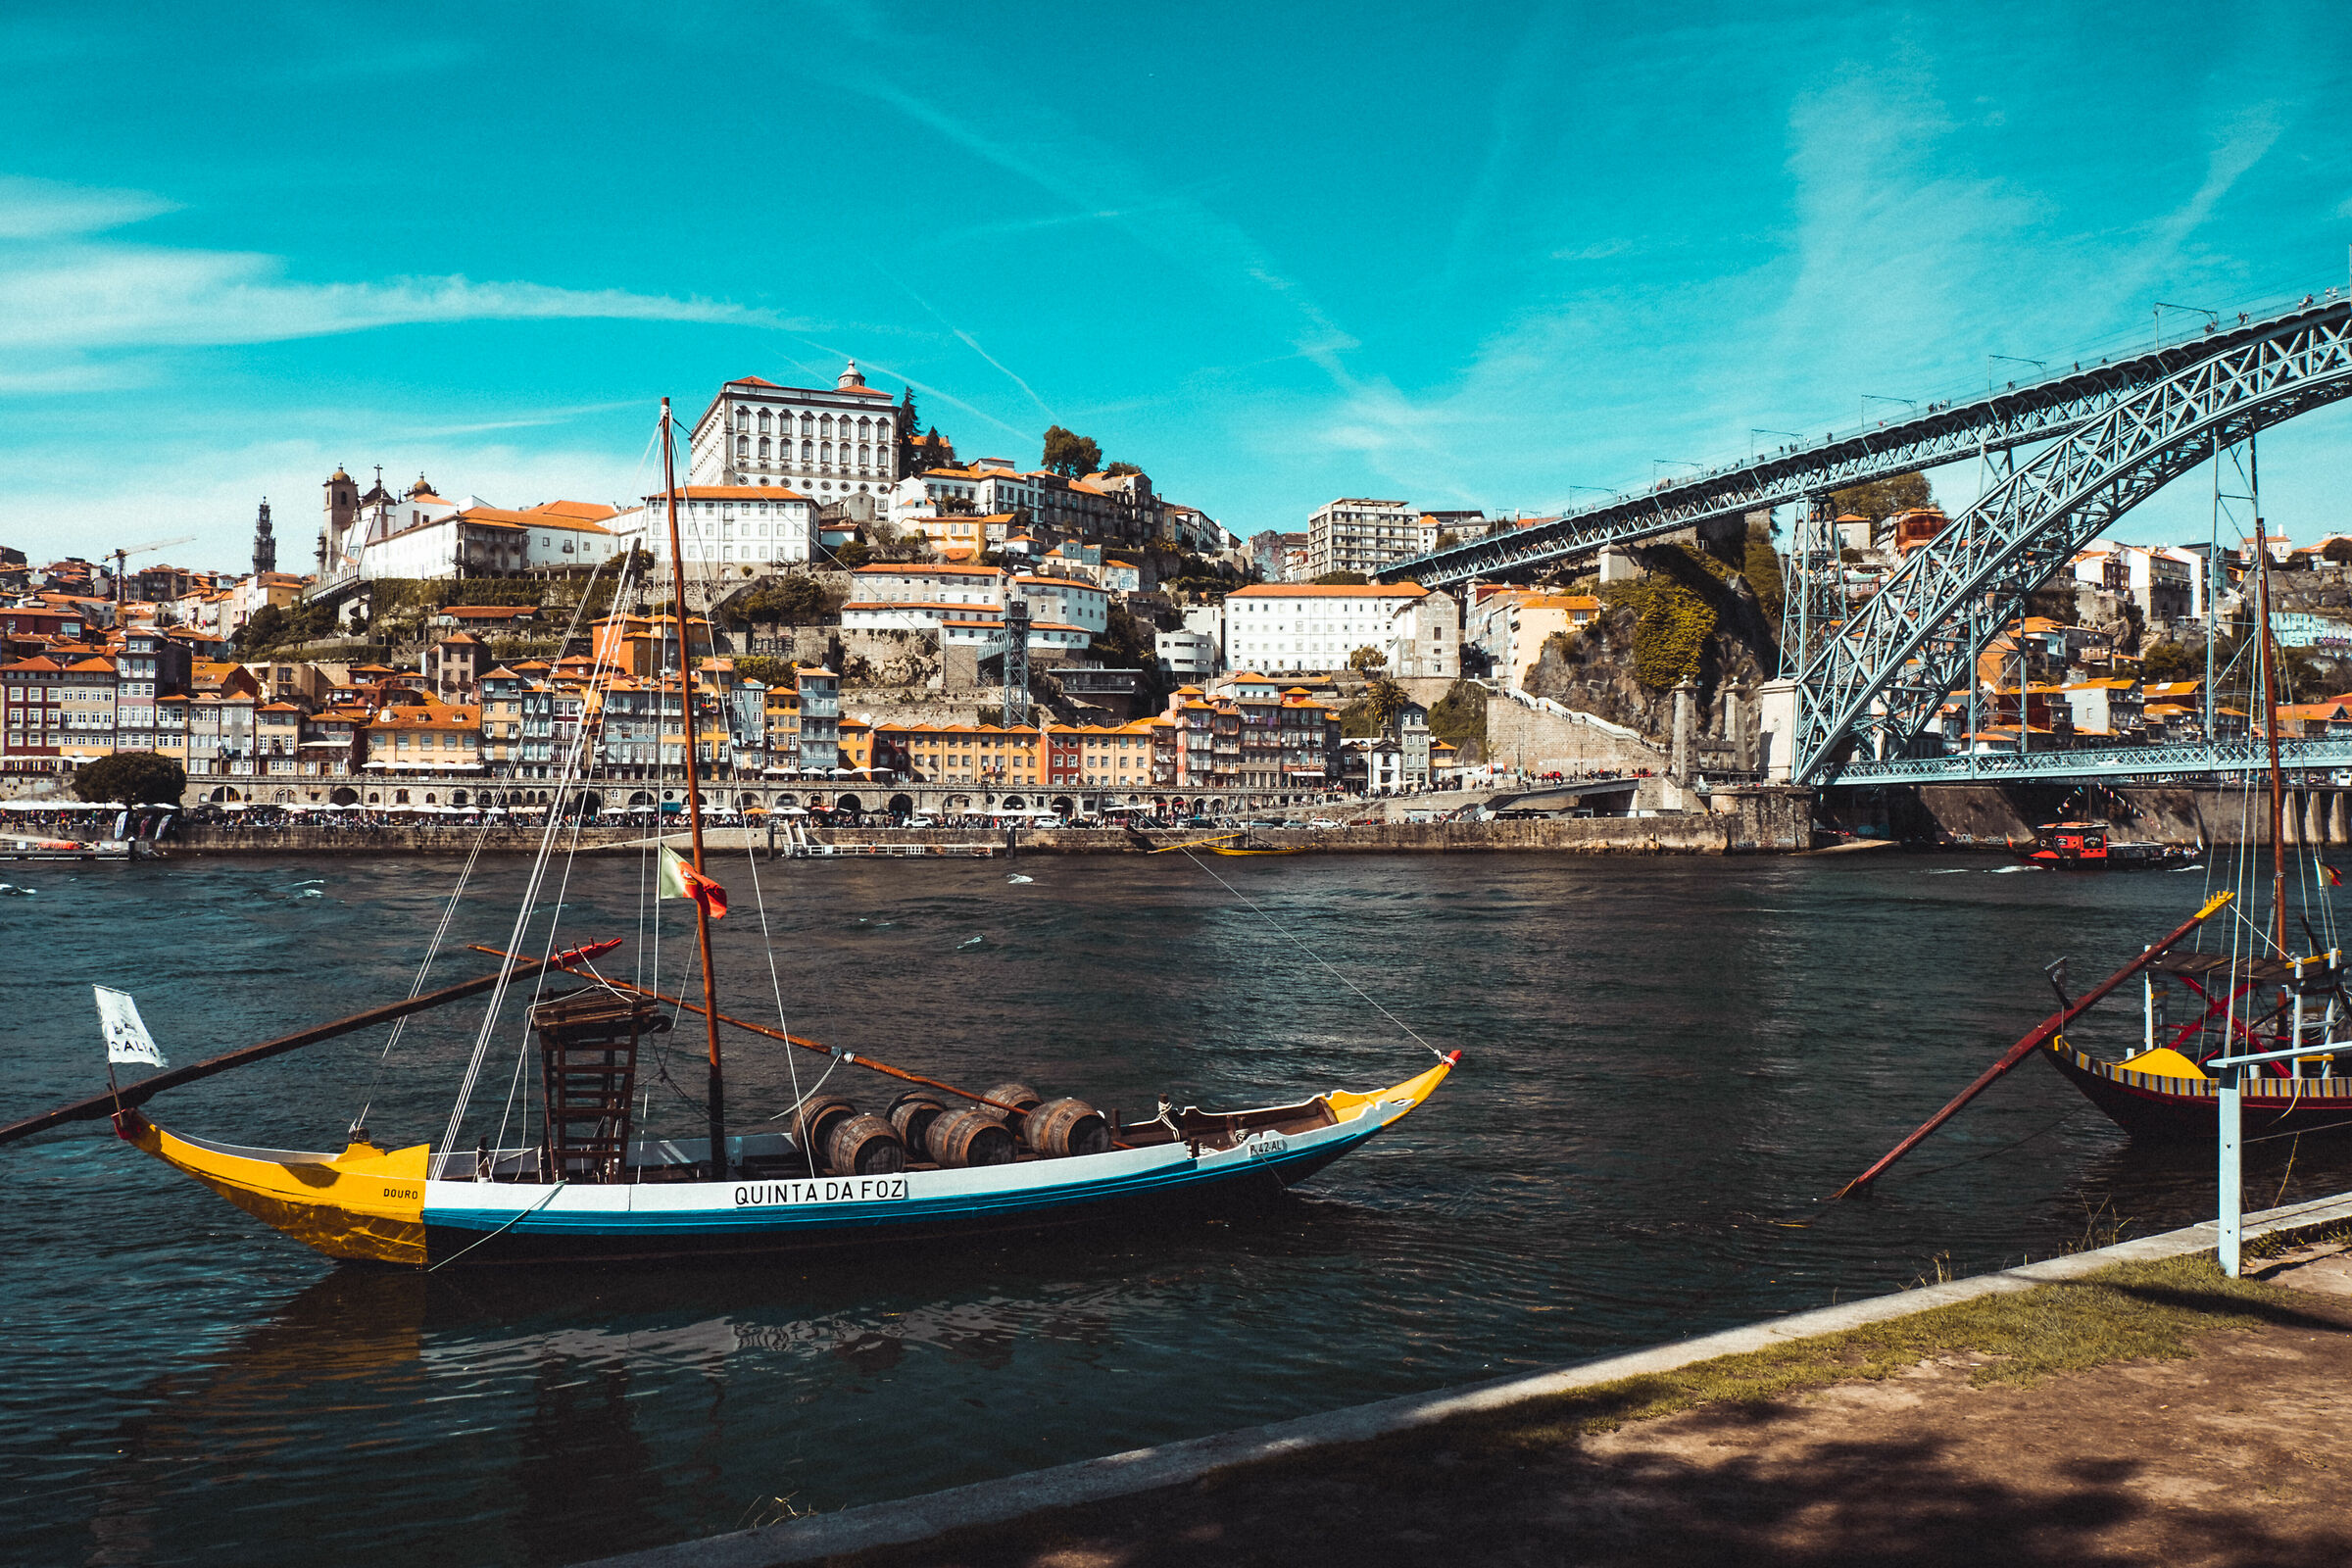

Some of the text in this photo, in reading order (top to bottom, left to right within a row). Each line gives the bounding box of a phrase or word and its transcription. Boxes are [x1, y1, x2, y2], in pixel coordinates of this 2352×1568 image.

[383, 1188, 418, 1200] DOURO
[735, 1180, 904, 1205] QUINTA DA FOZ
